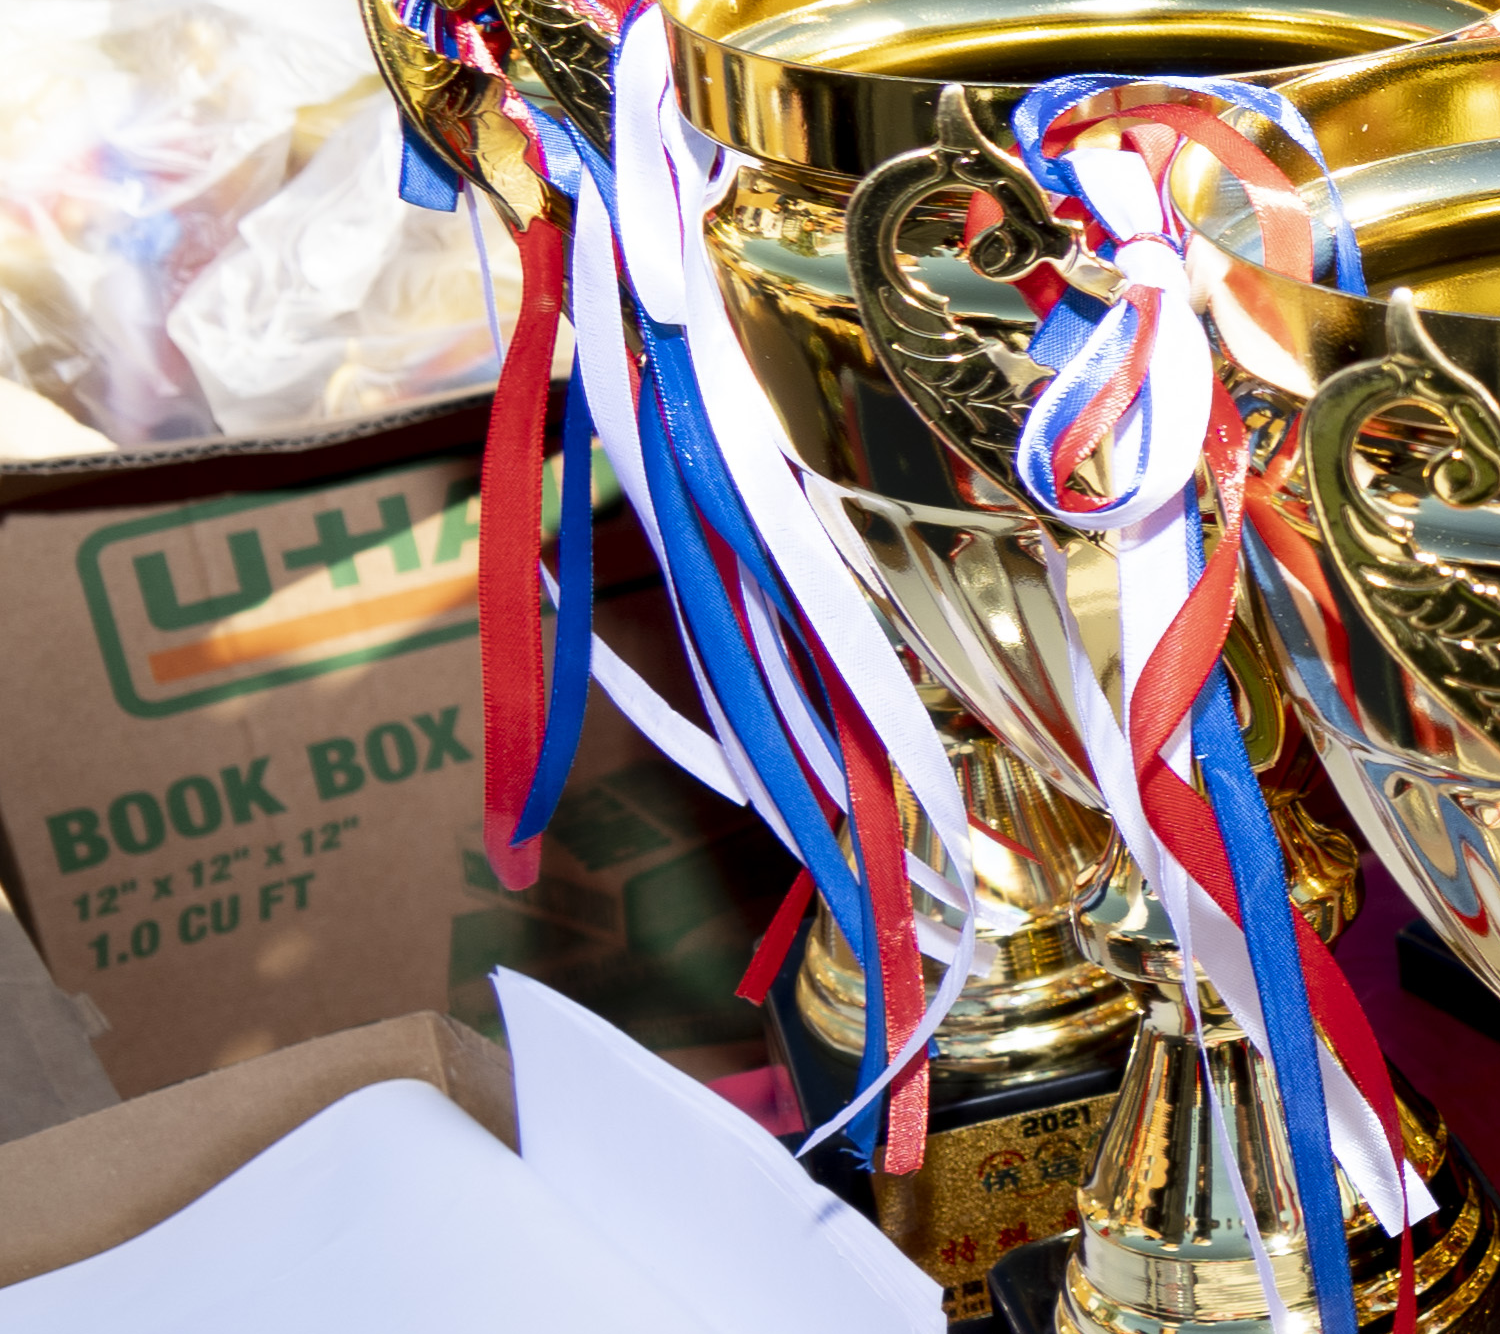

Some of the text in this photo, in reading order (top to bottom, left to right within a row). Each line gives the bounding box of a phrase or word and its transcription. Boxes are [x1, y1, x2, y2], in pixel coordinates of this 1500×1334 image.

[46, 704, 473, 875] BOOK BOX
[73, 814, 360, 922] 12" x 12" x 12"
[88, 871, 316, 971] 1.0 CU FT
[1020, 1104, 1091, 1138] 2021
